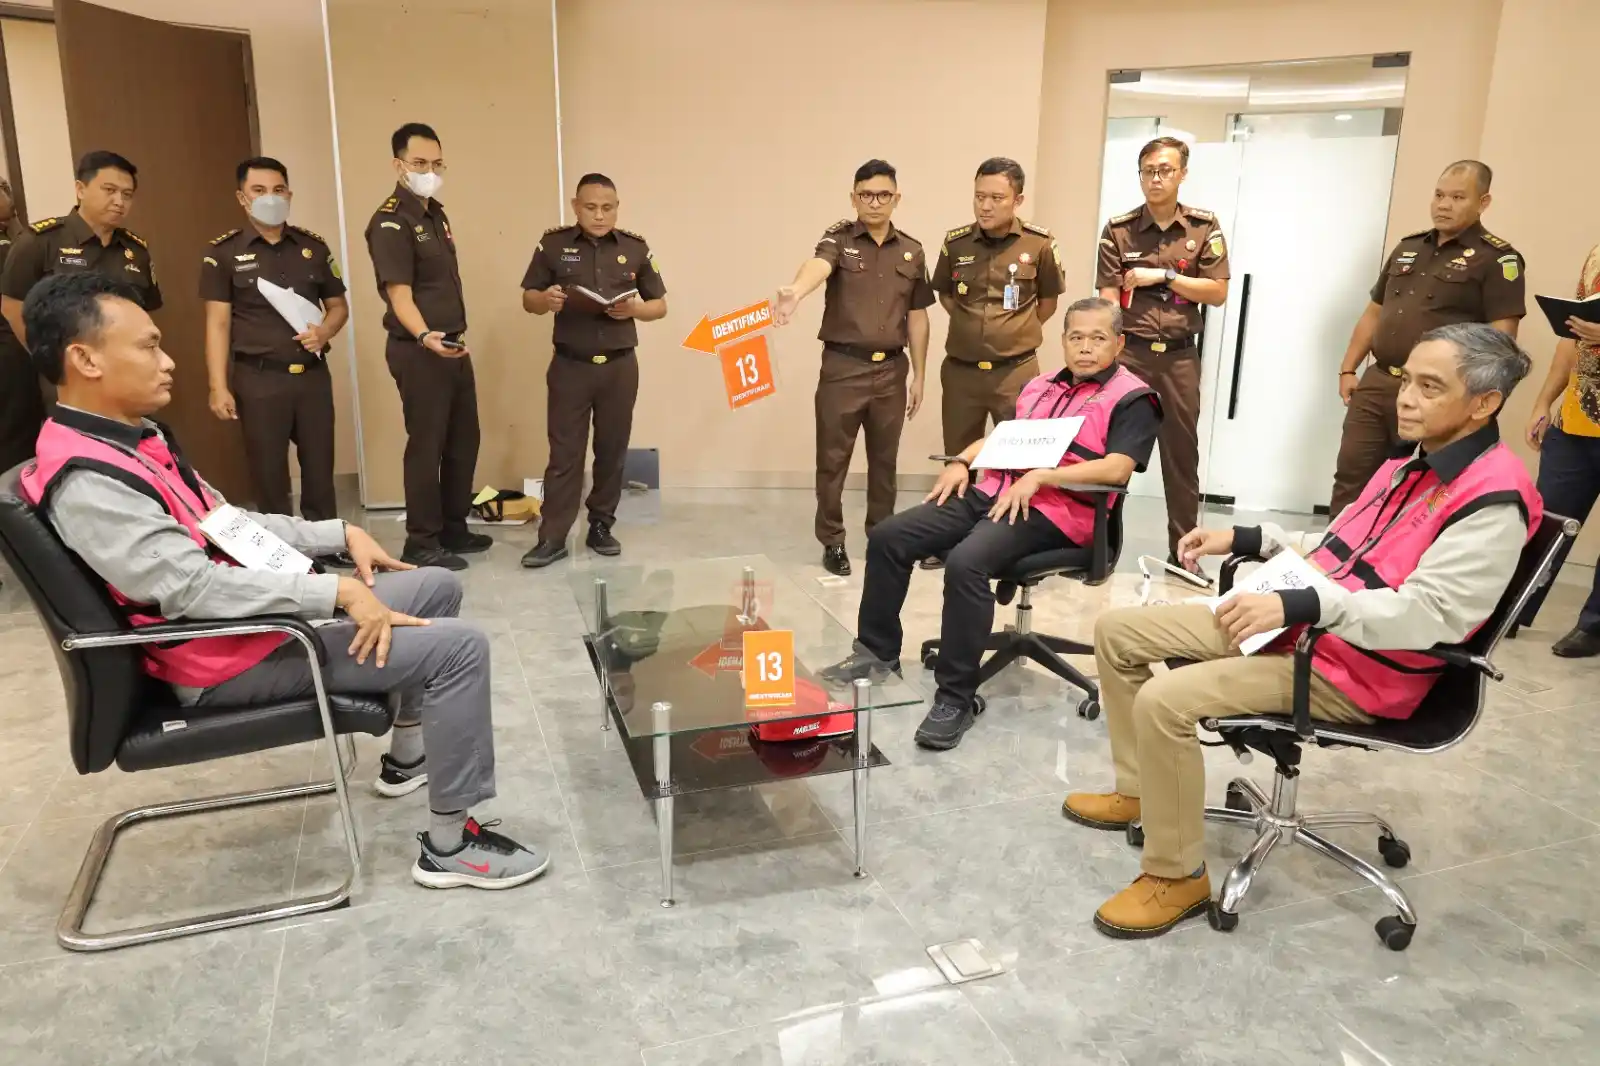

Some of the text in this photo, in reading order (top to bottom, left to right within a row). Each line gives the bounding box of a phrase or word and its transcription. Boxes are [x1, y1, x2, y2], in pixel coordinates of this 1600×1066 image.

[712, 307, 770, 340] IDENTIFIKASI
[735, 354, 760, 388] 13
[756, 651, 782, 681] 13
